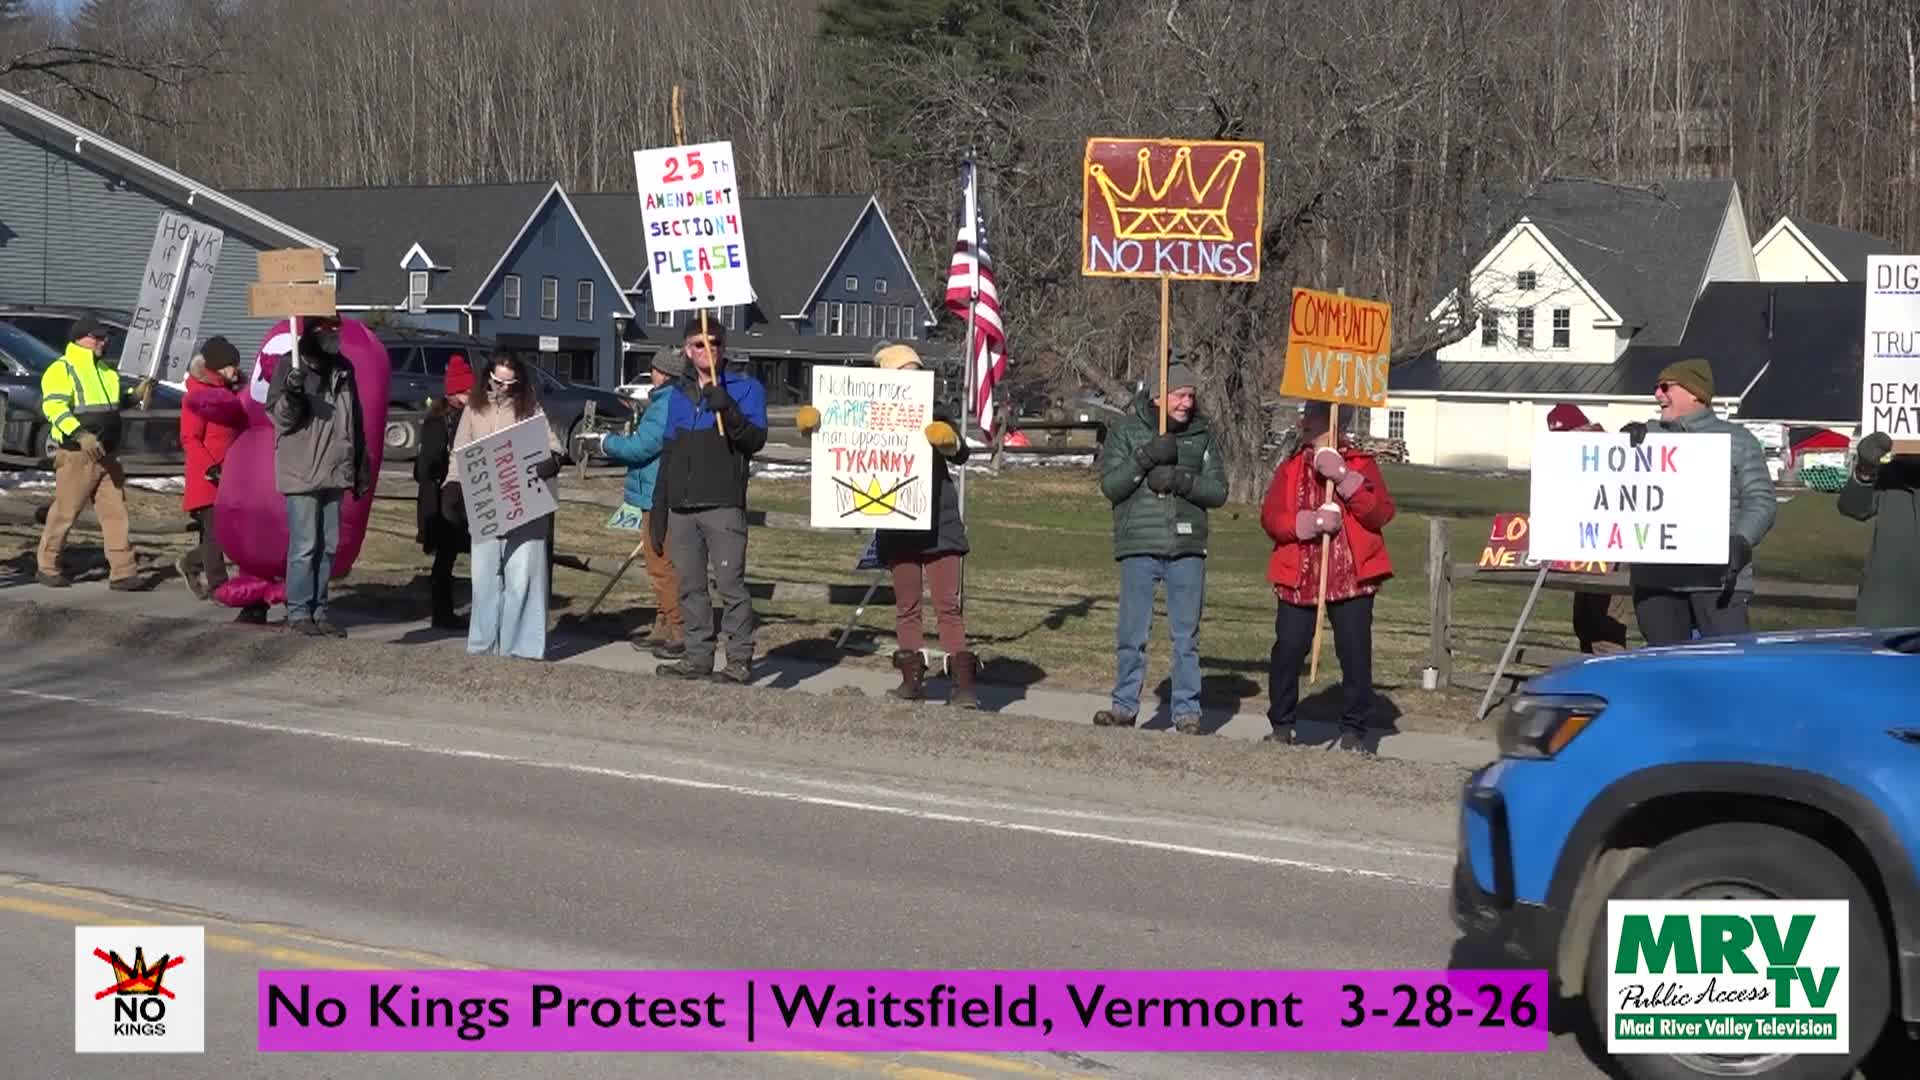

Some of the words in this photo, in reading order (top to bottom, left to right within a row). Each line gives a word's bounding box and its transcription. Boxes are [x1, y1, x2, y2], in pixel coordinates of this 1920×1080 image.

[646, 188, 732, 210] AMENDMENT
[163, 216, 218, 256] HONK
[653, 244, 741, 274] PLEASE
[1090, 235, 1143, 272] NO
[1154, 239, 1253, 276] KINGS
[149, 271, 176, 292] NOT
[1292, 291, 1389, 350] COMMUNITY
[819, 374, 875, 400] Nothing
[1302, 351, 1389, 401] WINS
[1871, 383, 1920, 404] DEM
[823, 399, 925, 432] AMERICAN
[851, 430, 909, 452] opposing
[829, 447, 915, 477] TYRANNY
[1581, 445, 1678, 472] HONK
[465, 446, 499, 536] GESTAPO
[494, 440, 525, 521] TRUMP'S
[1594, 485, 1664, 512] AND
[1579, 521, 1678, 550] WAVE
